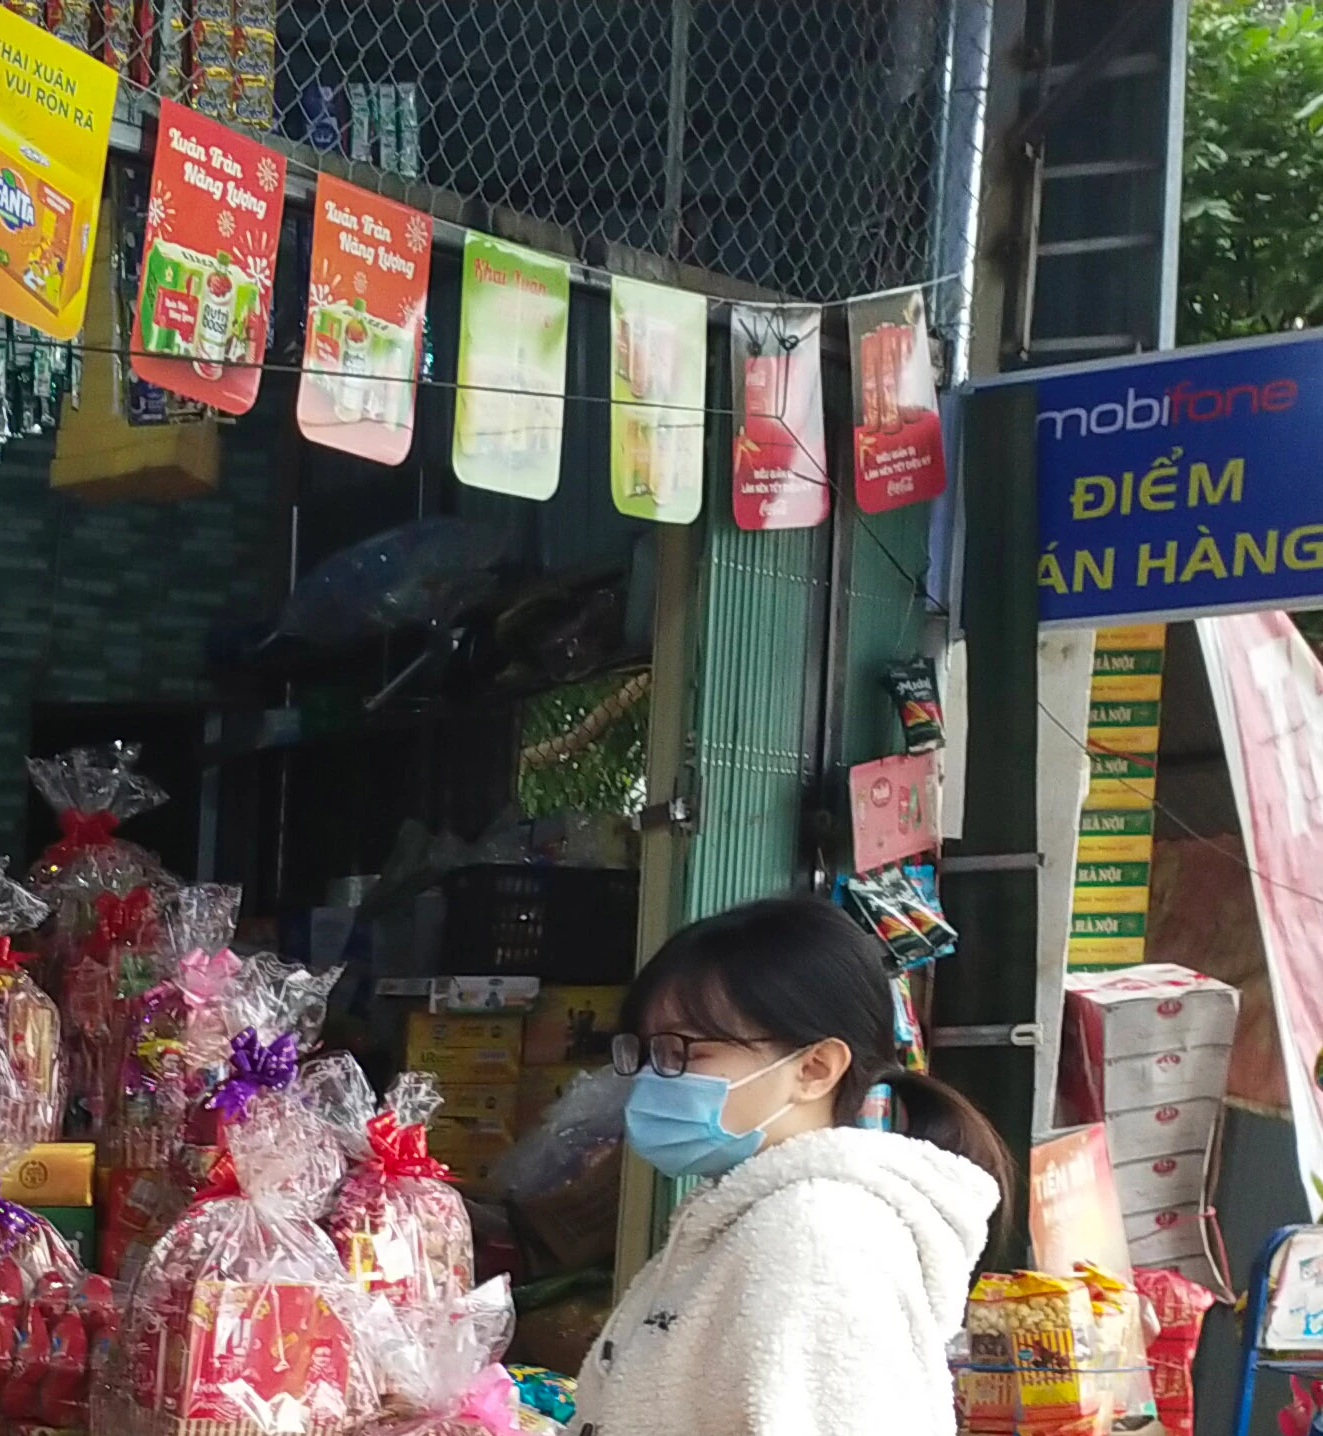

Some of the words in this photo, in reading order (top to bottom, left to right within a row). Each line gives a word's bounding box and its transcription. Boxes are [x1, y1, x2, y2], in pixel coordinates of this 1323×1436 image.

[5, 69, 31, 98] VUI
[36, 86, 70, 119] RỘN
[74, 107, 94, 132] RÃ
[34, 59, 77, 96] XUÂN
[169, 127, 208, 162] Xuân
[210, 146, 243, 179] Tràn
[184, 161, 223, 200] Năng
[227, 181, 267, 220] Lượng
[339, 231, 375, 265] Năng
[362, 215, 392, 243] Tràn
[1037, 379, 1297, 440] mobifone
[1069, 446, 1245, 520] ĐIỂM
[1136, 525, 1323, 587] HÀNG
